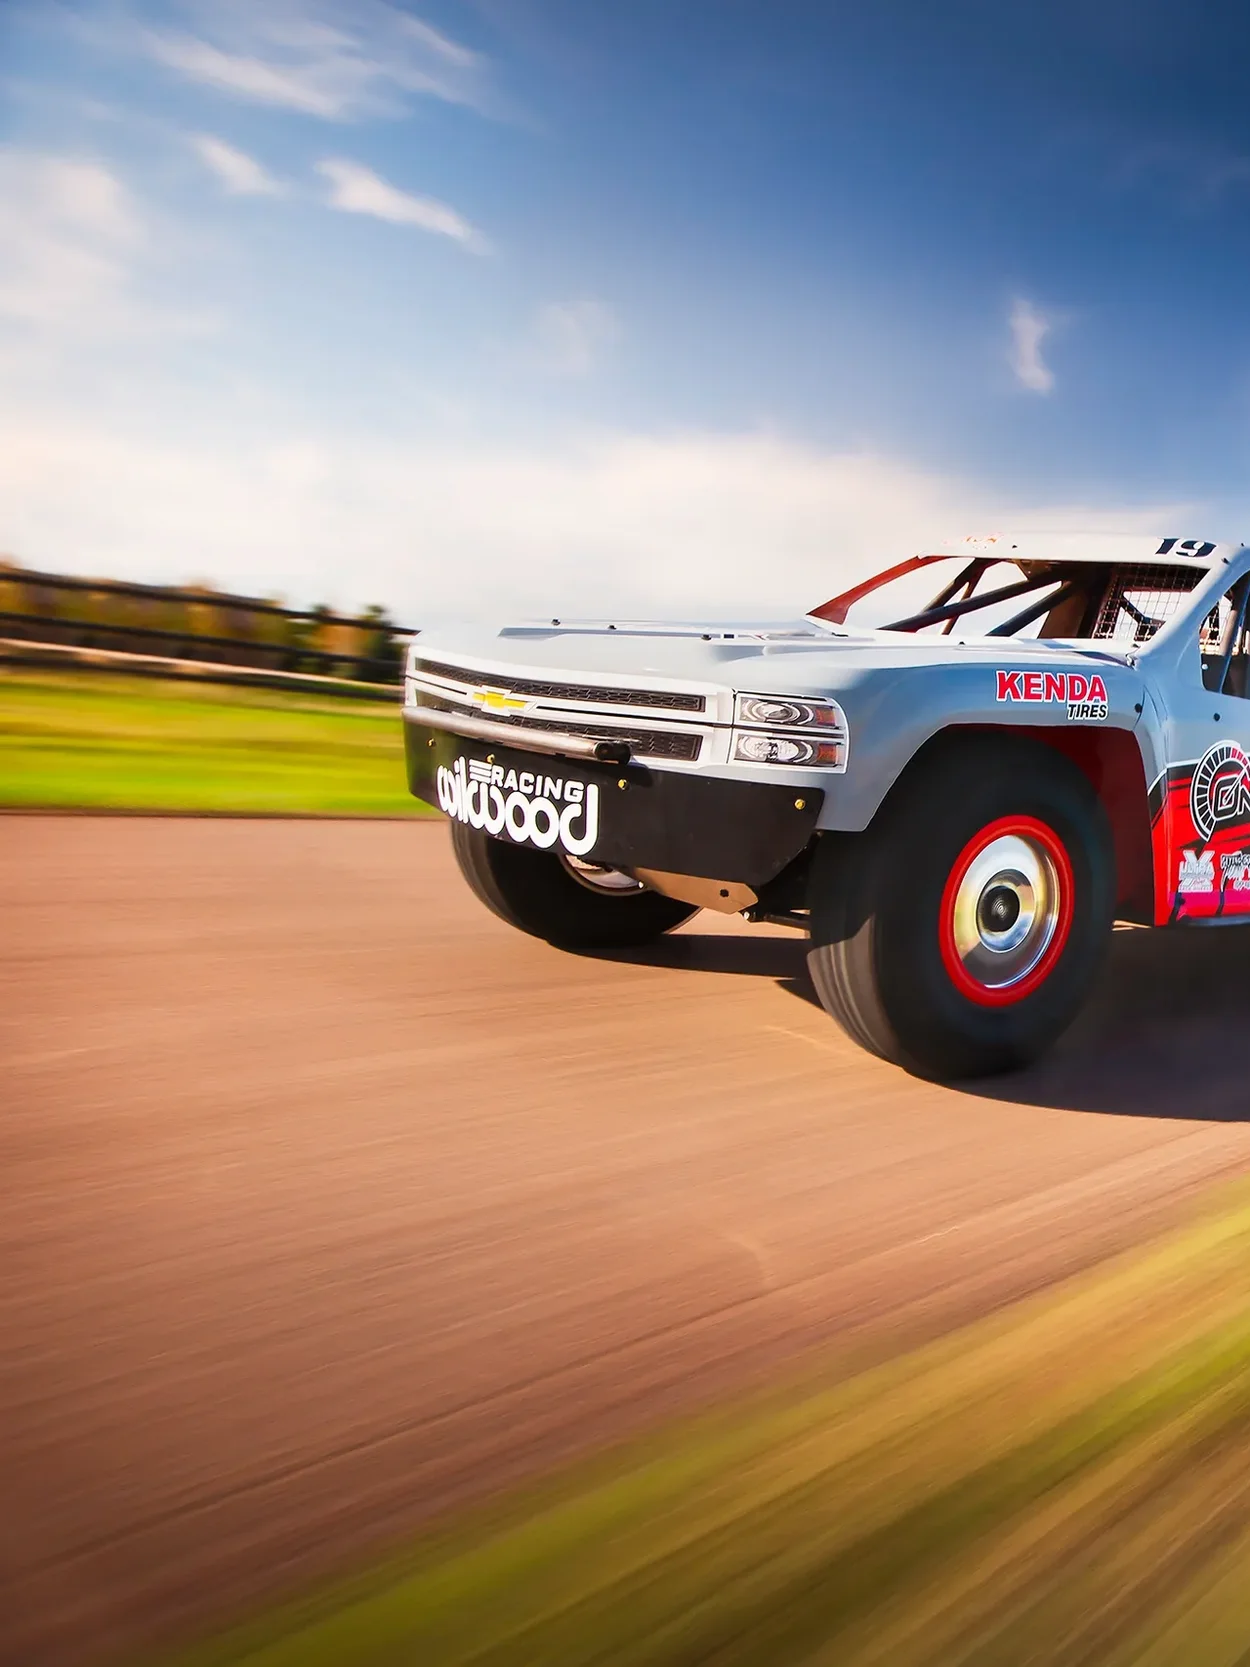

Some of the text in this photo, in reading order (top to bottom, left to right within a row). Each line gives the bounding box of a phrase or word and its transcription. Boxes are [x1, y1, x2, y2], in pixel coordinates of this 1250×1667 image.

[1154, 537, 1217, 558] 19
[997, 671, 1107, 702] KENDA
[1068, 703, 1107, 719] TIRES
[490, 764, 584, 803] RACING
[436, 756, 599, 856] wilwood
